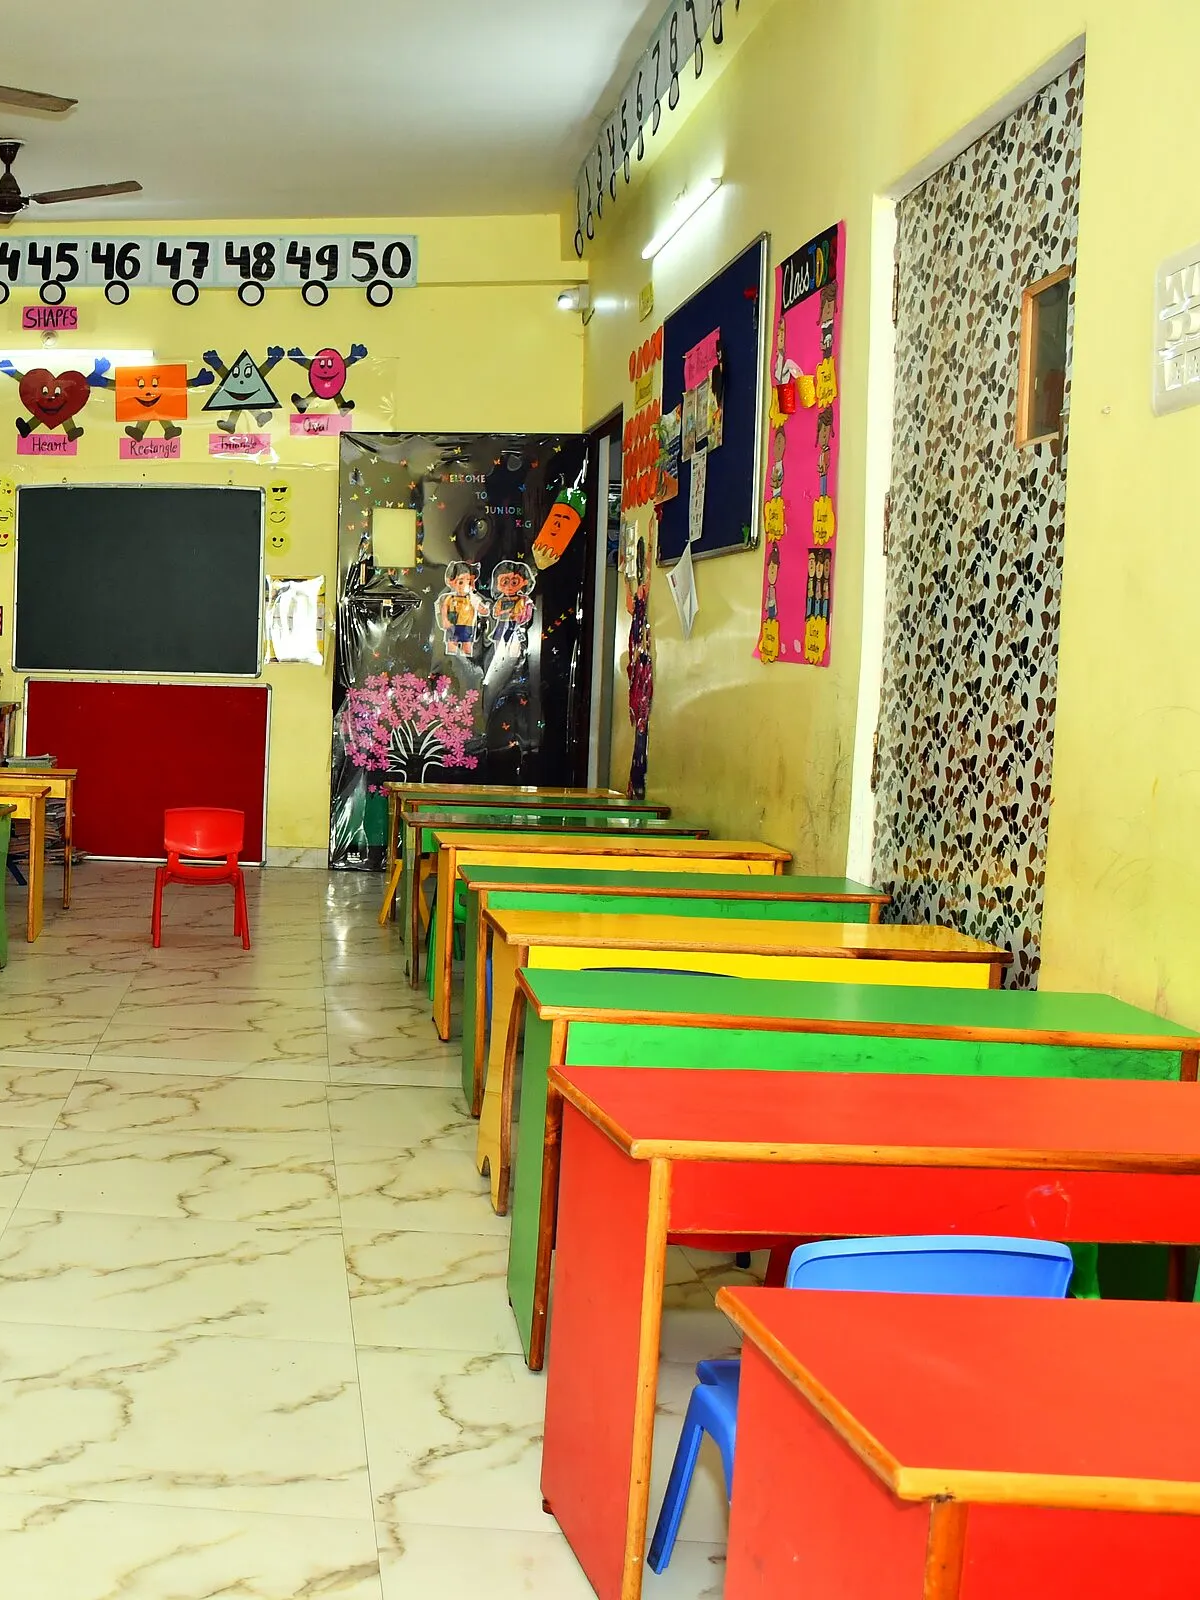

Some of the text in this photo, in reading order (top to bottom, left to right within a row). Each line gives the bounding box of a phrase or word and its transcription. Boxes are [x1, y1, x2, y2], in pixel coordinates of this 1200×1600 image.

[28, 242, 79, 282] 45
[91, 242, 141, 280] 46
[156, 241, 210, 279] 47
[225, 241, 275, 281] 48
[286, 240, 338, 281] 49
[351, 240, 411, 282] 50
[783, 259, 810, 309] Class
[31, 436, 68, 452] Heart
[129, 440, 178, 459] Rectangle
[440, 474, 486, 483] WELCOME
[475, 491, 488, 499] TO
[484, 506, 522, 515] JUNIOR
